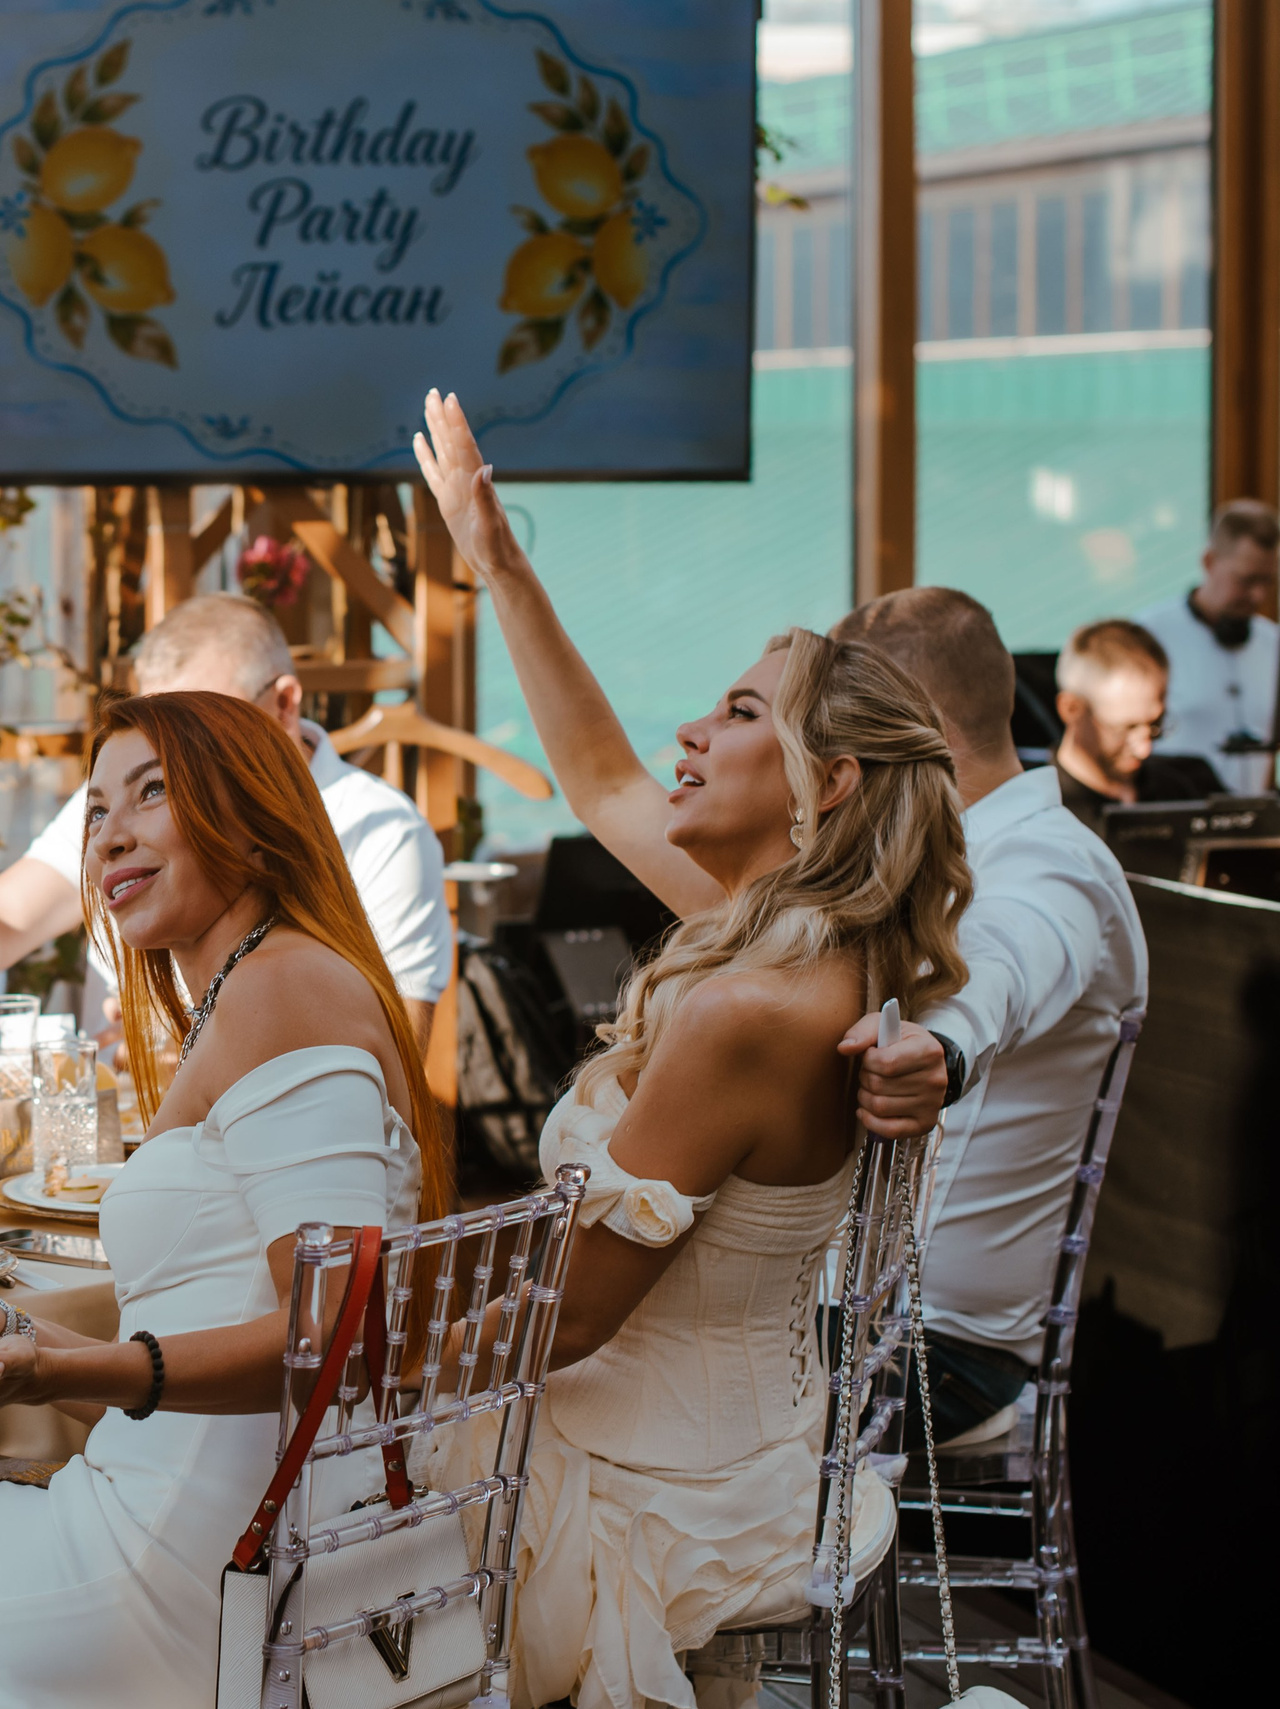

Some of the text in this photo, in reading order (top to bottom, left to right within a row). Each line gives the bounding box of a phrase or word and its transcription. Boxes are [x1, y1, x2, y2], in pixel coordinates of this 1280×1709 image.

[194, 94, 478, 198] Birthday
[247, 176, 423, 273] Party
[214, 261, 450, 330] Лейсан
